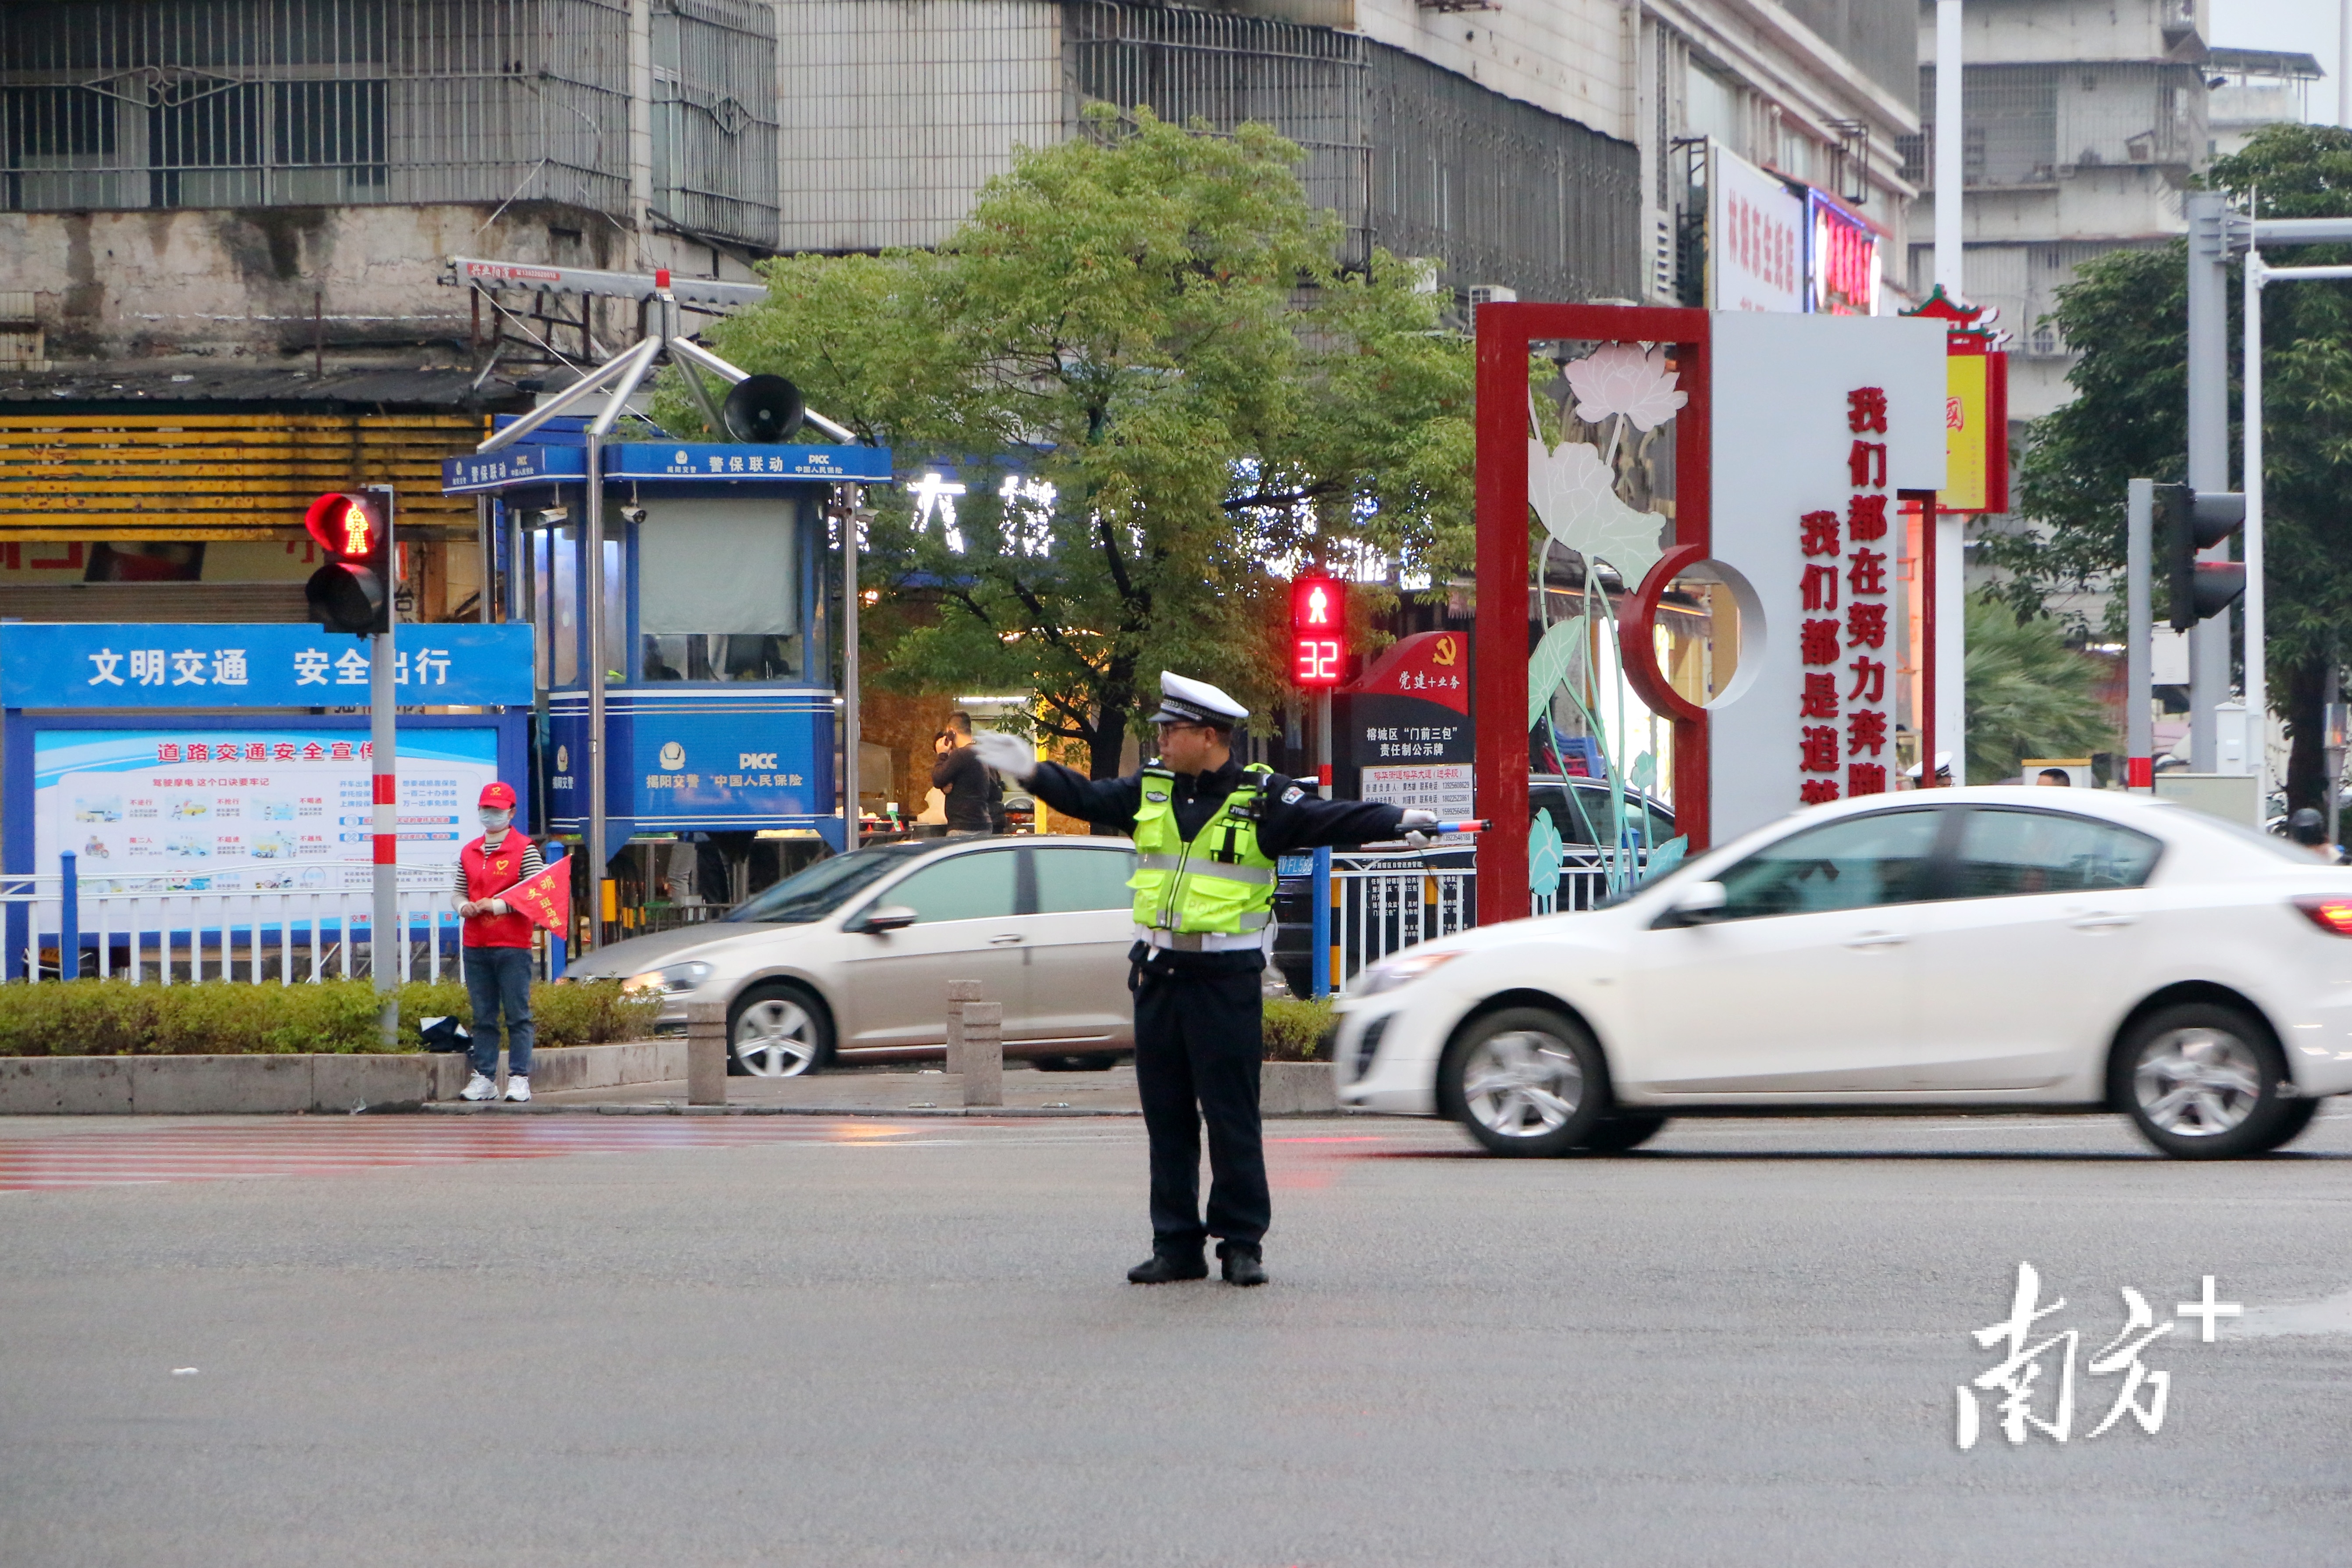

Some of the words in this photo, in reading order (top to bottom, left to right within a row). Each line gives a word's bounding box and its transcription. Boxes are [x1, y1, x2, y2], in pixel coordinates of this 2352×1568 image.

[709, 456, 783, 472] 警保联动
[809, 455, 829, 464] PICC
[88, 648, 249, 686] 文明交通
[1299, 641, 1338, 678] 32
[1399, 670, 1460, 690] 党建+业务
[1380, 743, 1444, 757] 责任制公示牌
[739, 753, 777, 770] PICC
[646, 774, 699, 788] 揭阳交警
[714, 774, 802, 787] 中国人民保险
